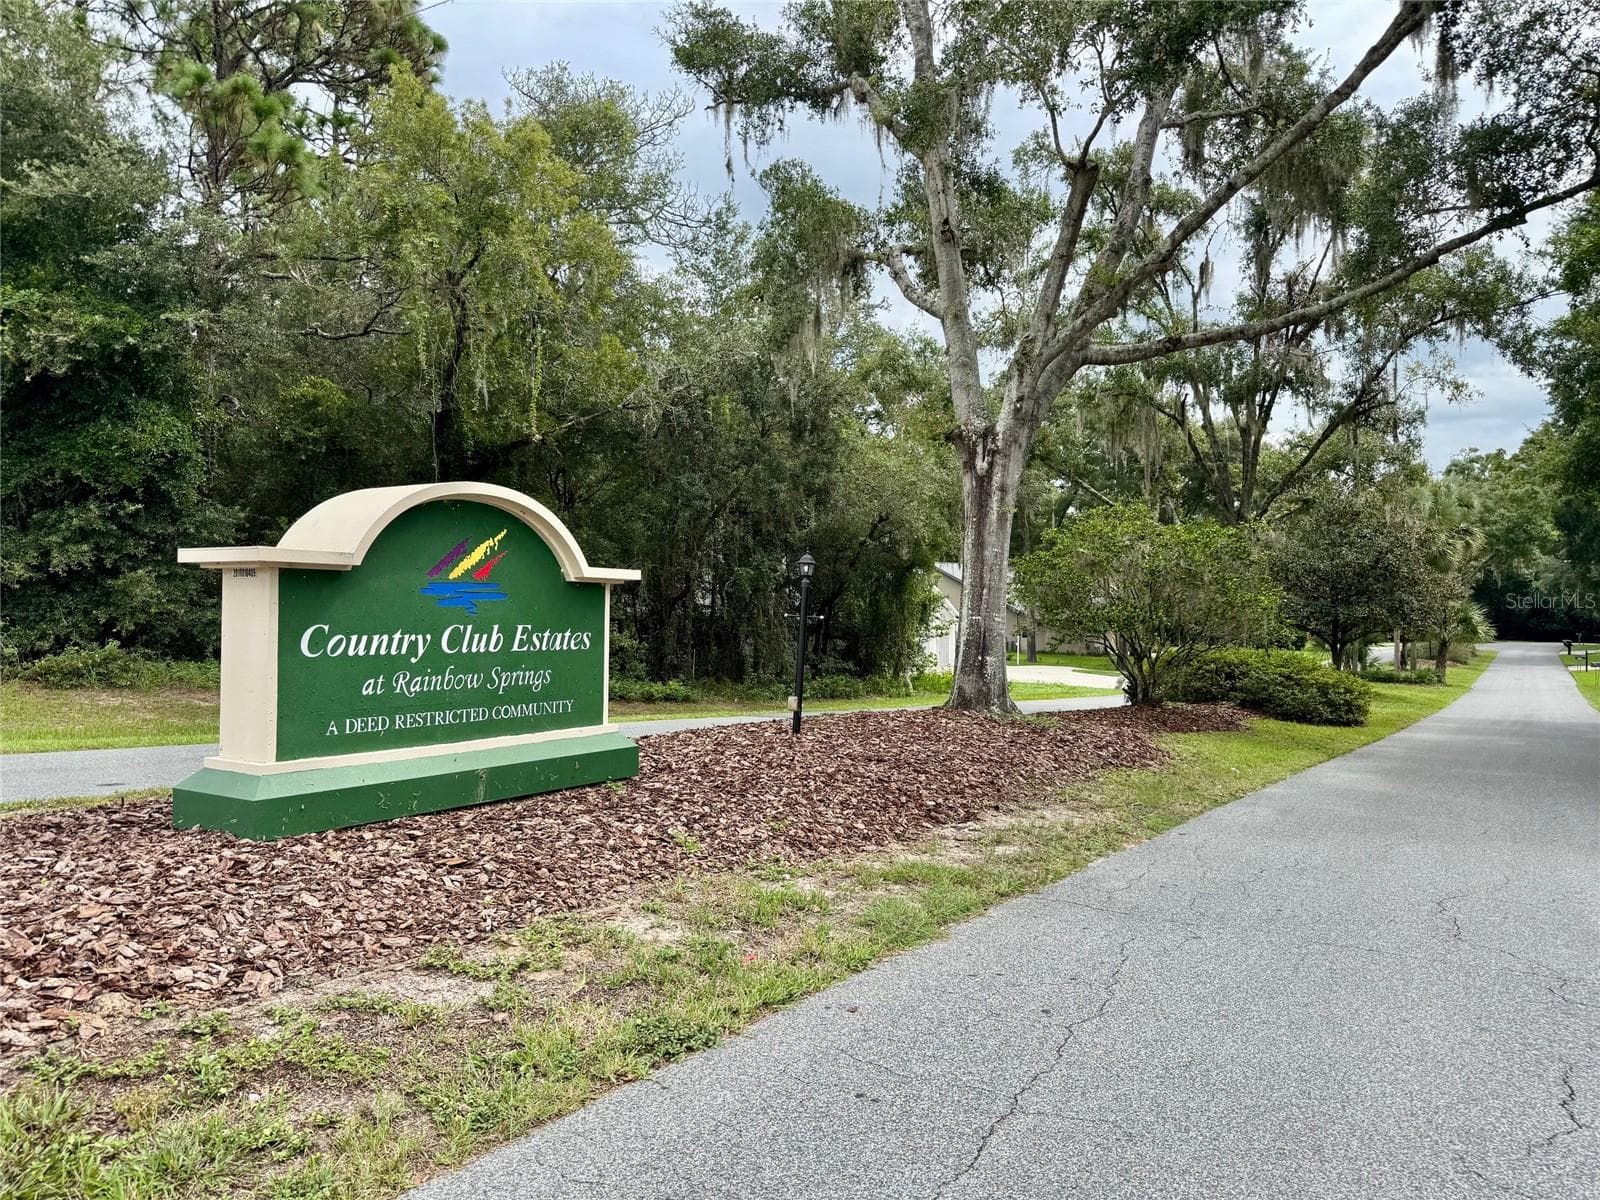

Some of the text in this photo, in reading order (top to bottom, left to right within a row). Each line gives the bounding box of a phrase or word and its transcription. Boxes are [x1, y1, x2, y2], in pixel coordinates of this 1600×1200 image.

[300, 623, 592, 663] Country Club Estates
[361, 665, 552, 697] at Rainbow Springs
[326, 699, 574, 736] A DEED RESTRICTED COMMUNITY
